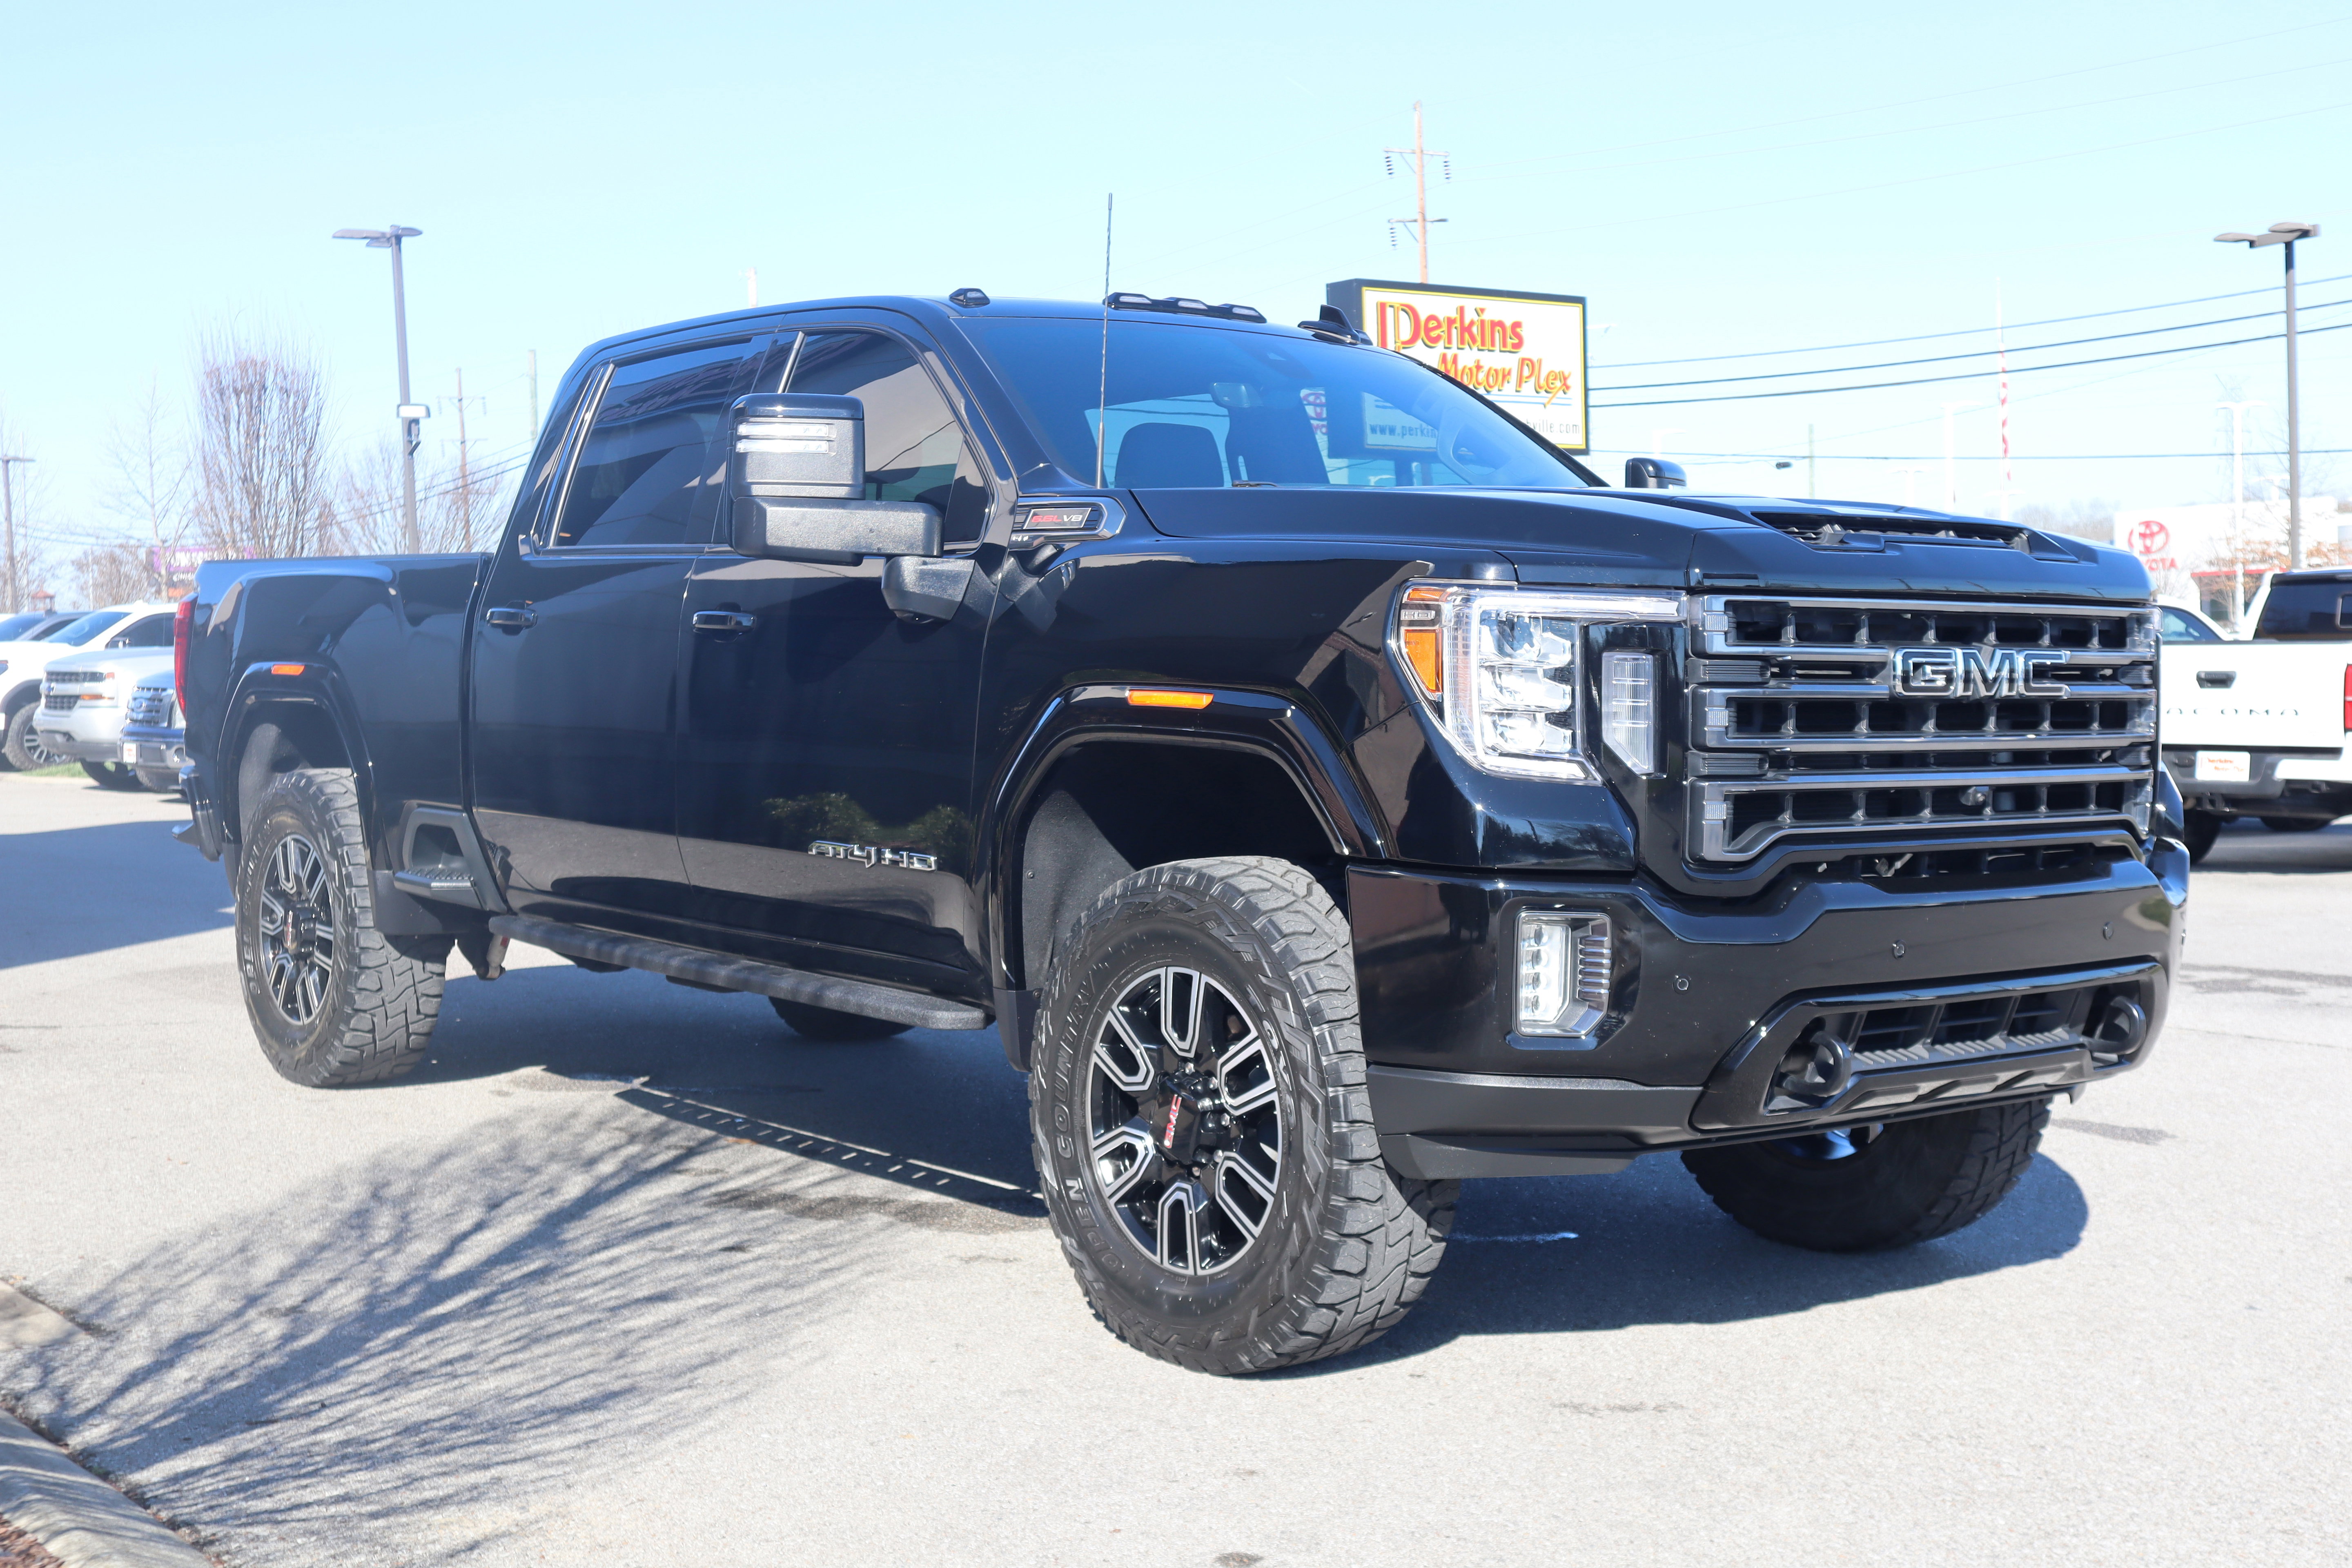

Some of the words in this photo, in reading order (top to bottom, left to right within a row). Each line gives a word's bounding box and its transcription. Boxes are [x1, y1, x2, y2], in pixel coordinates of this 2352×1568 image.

[1377, 301, 1524, 352] Perkins
[1438, 352, 1512, 391] Motor
[1515, 357, 1572, 408] Plex
[1063, 514, 1083, 522] V8
[2141, 557, 2180, 571] YOTA
[1893, 647, 2071, 699] GMC
[2166, 708, 2299, 716] ACOMA
[1054, 970, 1095, 1159] COUNTRY
[1164, 1094, 1183, 1149] GMC
[1065, 1177, 1124, 1273] OPEN
